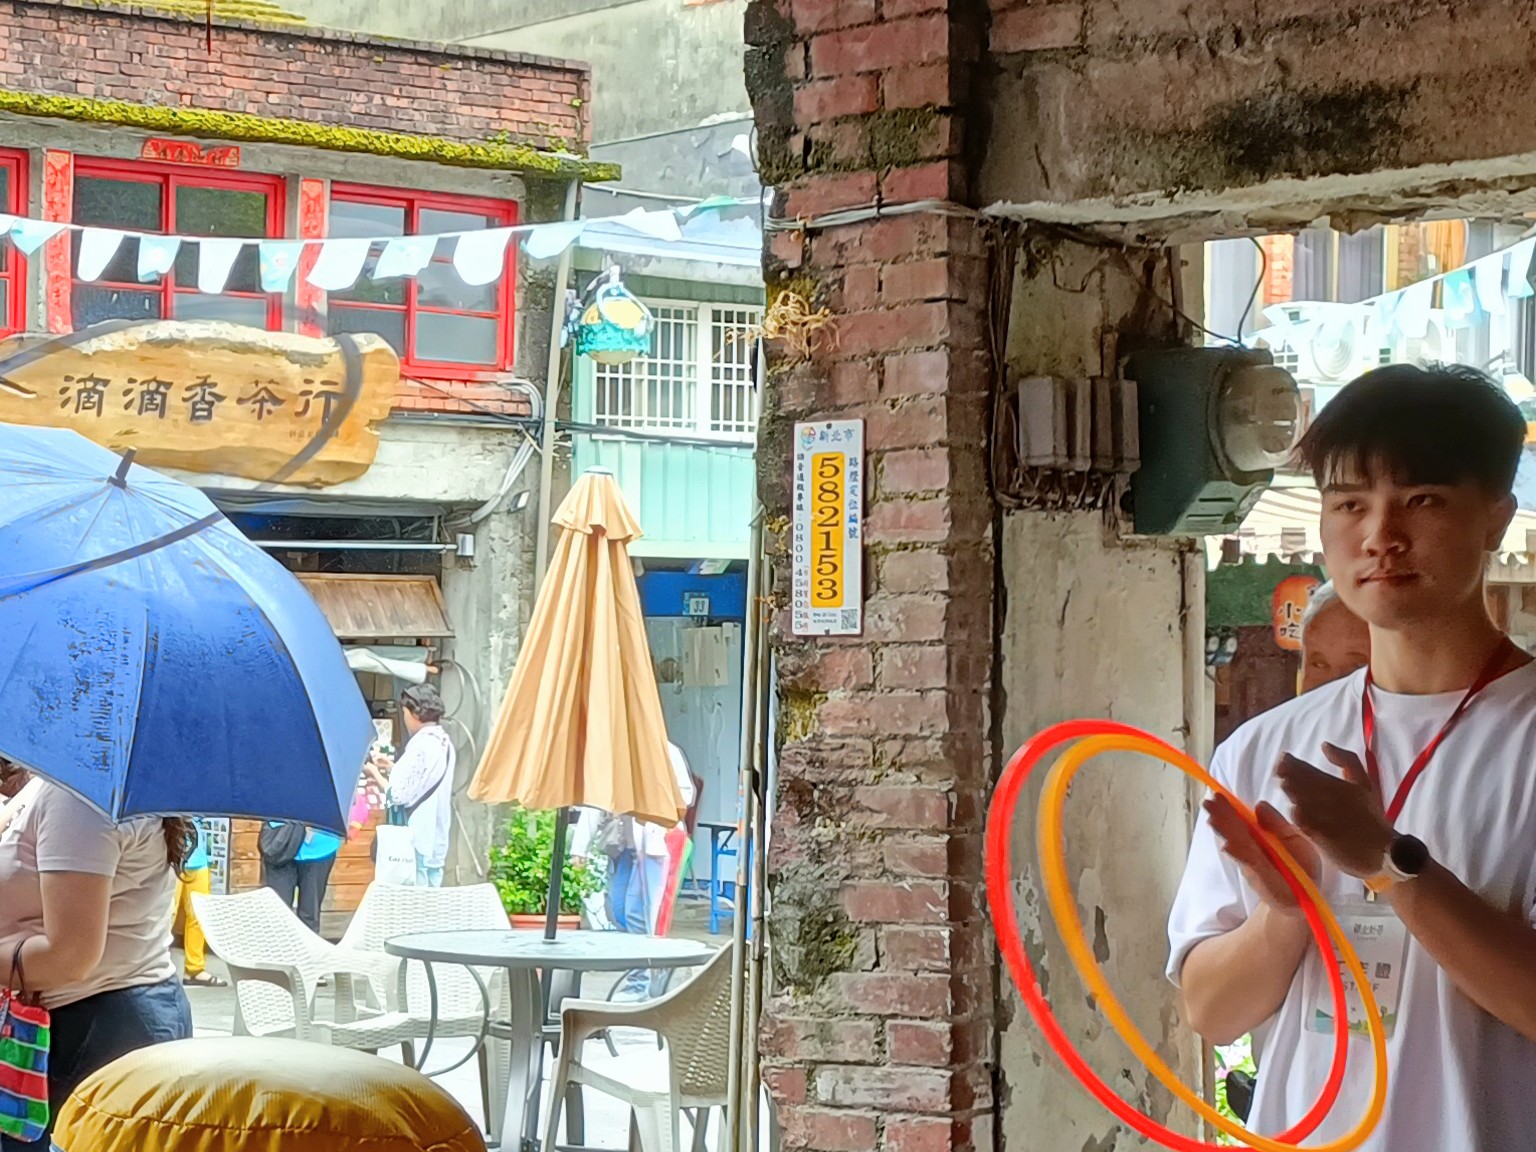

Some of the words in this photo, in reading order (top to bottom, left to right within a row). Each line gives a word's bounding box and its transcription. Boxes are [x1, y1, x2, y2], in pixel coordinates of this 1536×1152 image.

[58, 372, 344, 426] 滴滴香茶行
[818, 428, 855, 443] 新北市
[815, 456, 841, 601] 582153
